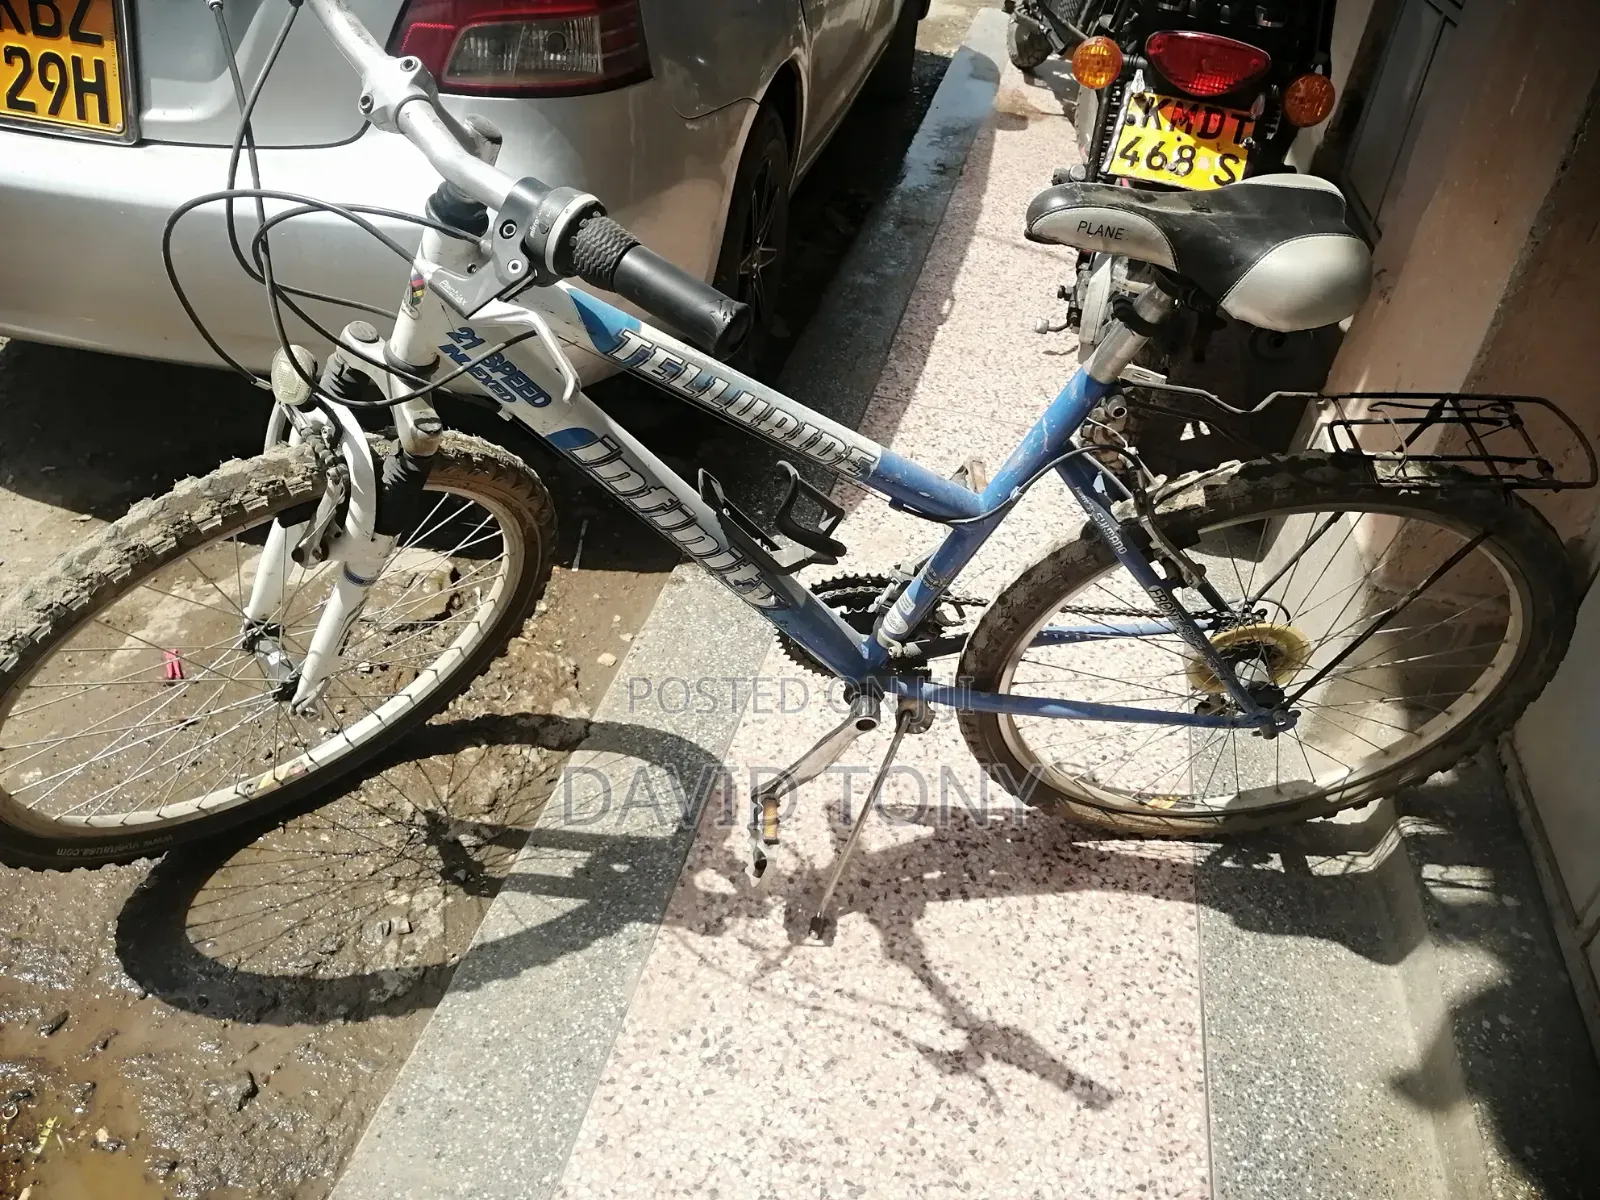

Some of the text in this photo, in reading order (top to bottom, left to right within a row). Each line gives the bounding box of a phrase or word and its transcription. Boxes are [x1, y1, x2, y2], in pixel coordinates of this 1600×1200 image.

[3, 45, 110, 124] 29H
[1141, 97, 1256, 145] KMDT
[1119, 136, 1240, 187] 468 S
[438, 344, 517, 403] INEXED
[446, 327, 552, 408] 21 SPEED
[606, 329, 879, 480] TELLURIDE
